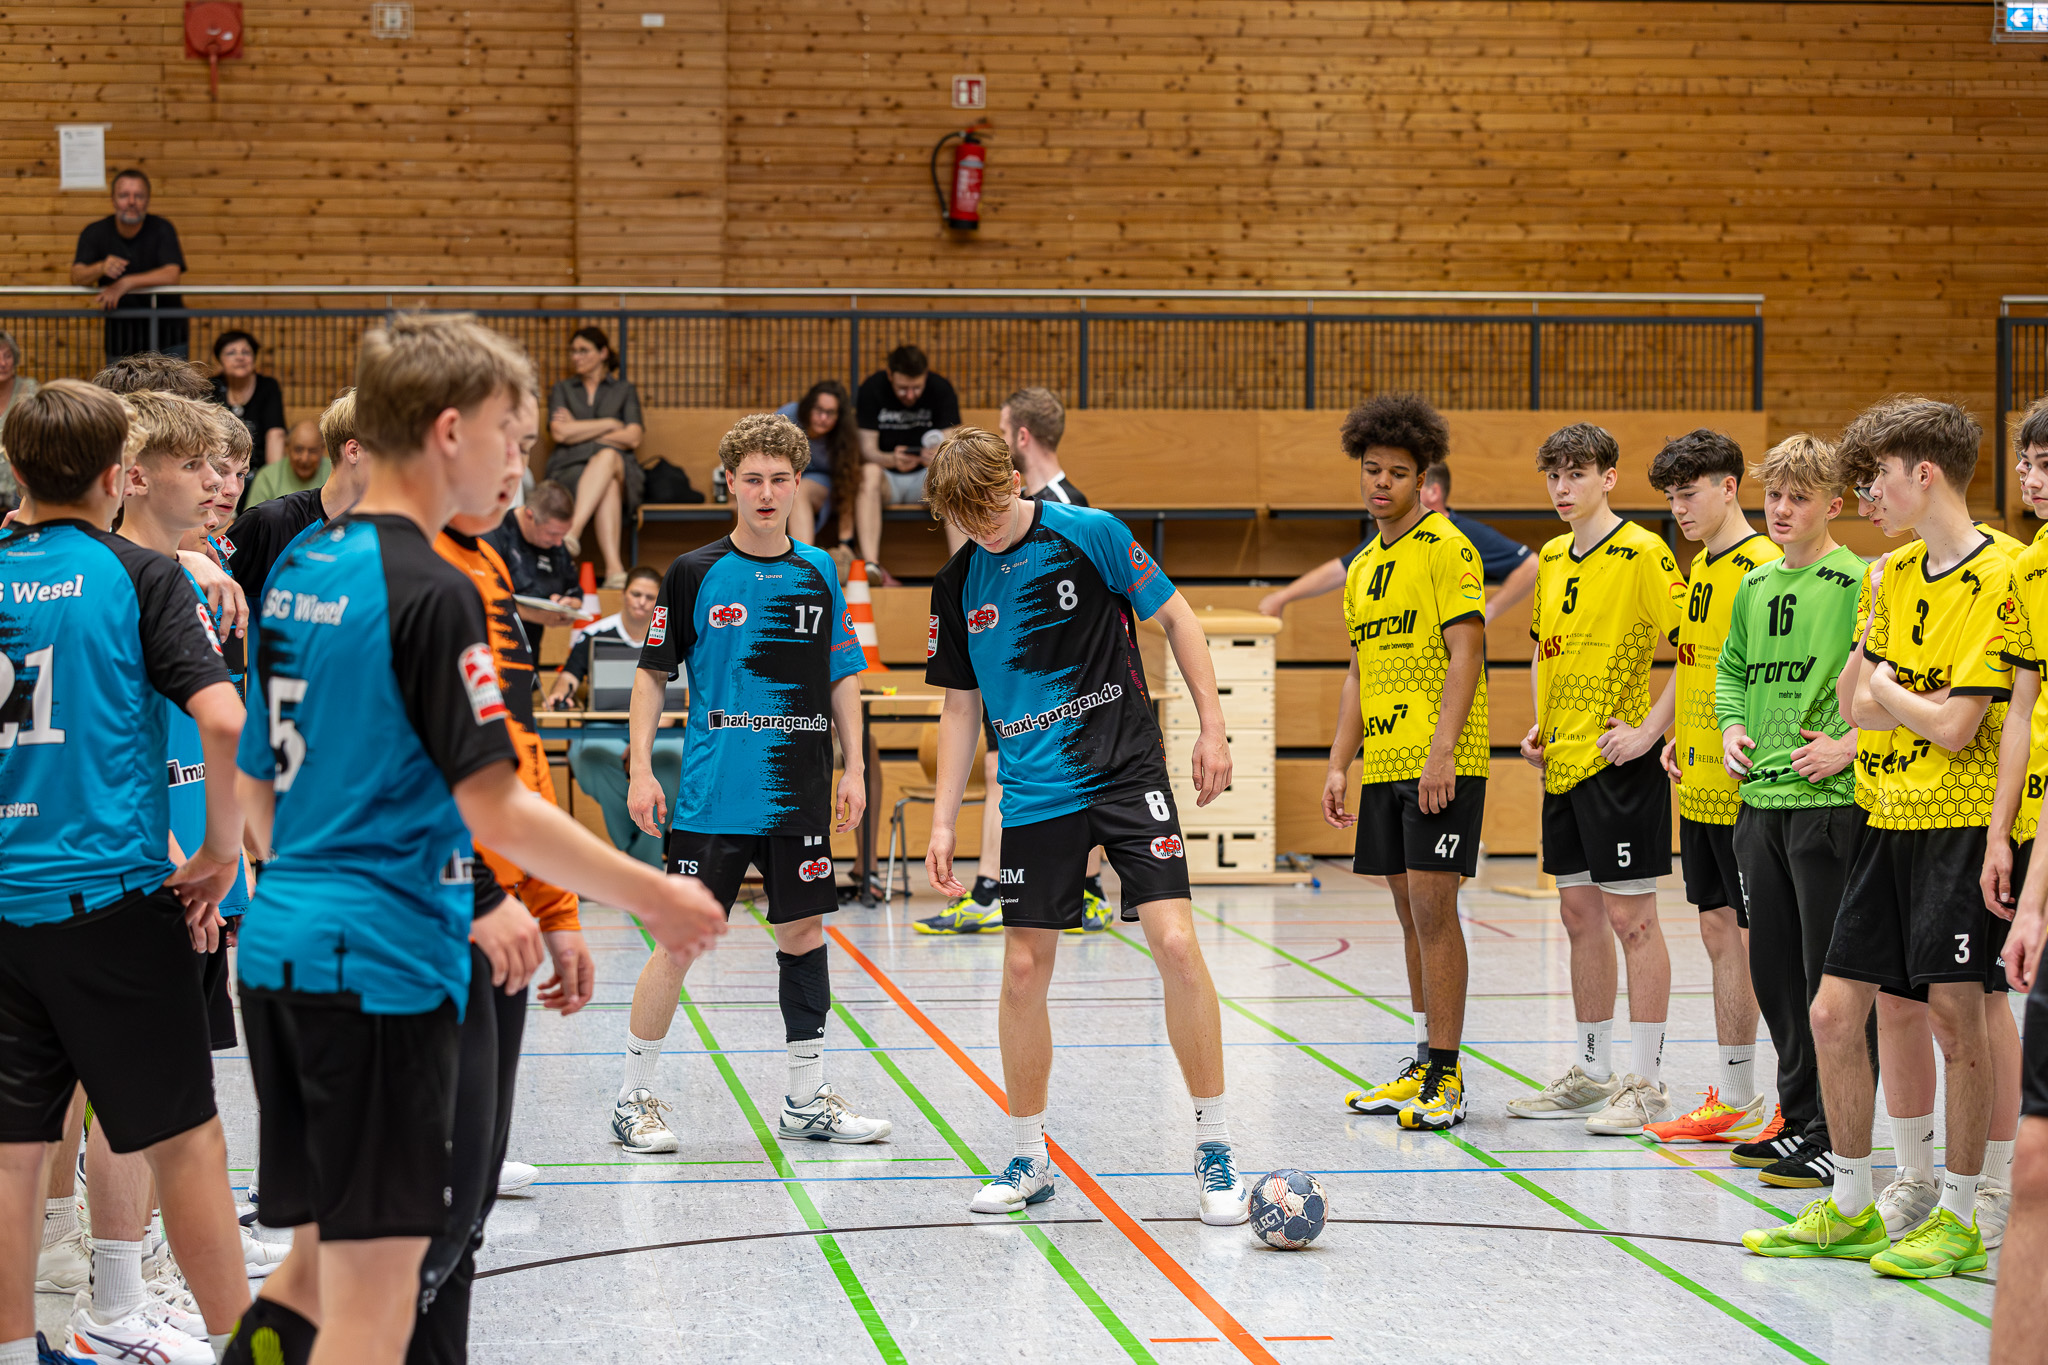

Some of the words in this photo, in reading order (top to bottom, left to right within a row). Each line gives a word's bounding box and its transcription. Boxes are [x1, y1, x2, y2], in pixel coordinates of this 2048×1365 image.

[1413, 530, 1440, 543] WTV
[1605, 544, 1639, 560] WTV
[11, 575, 83, 604] Wesel
[1816, 566, 1856, 588] WTV
[294, 592, 349, 626] Wesel
[1057, 579, 1078, 610] 8
[1561, 577, 1580, 615] 5
[1688, 582, 1713, 623] 60
[713, 607, 743, 622] HSG
[794, 605, 823, 635] 17
[968, 610, 996, 628] HSG
[1767, 593, 1798, 637] 16
[1912, 599, 1930, 646] 3
[1003, 683, 1123, 737] maxi-garagen.de
[268, 676, 307, 792] 5
[1145, 790, 1171, 822] 8
[1155, 839, 1182, 853] HSG
[1217, 834, 1238, 868] L
[1434, 833, 1461, 859] 47
[1617, 842, 1631, 868] 5
[678, 860, 699, 875] TS
[803, 862, 829, 876] HSG
[1000, 868, 1025, 884] HM
[1954, 934, 1970, 964] 3
[1587, 1033, 1595, 1055] CRAFT
